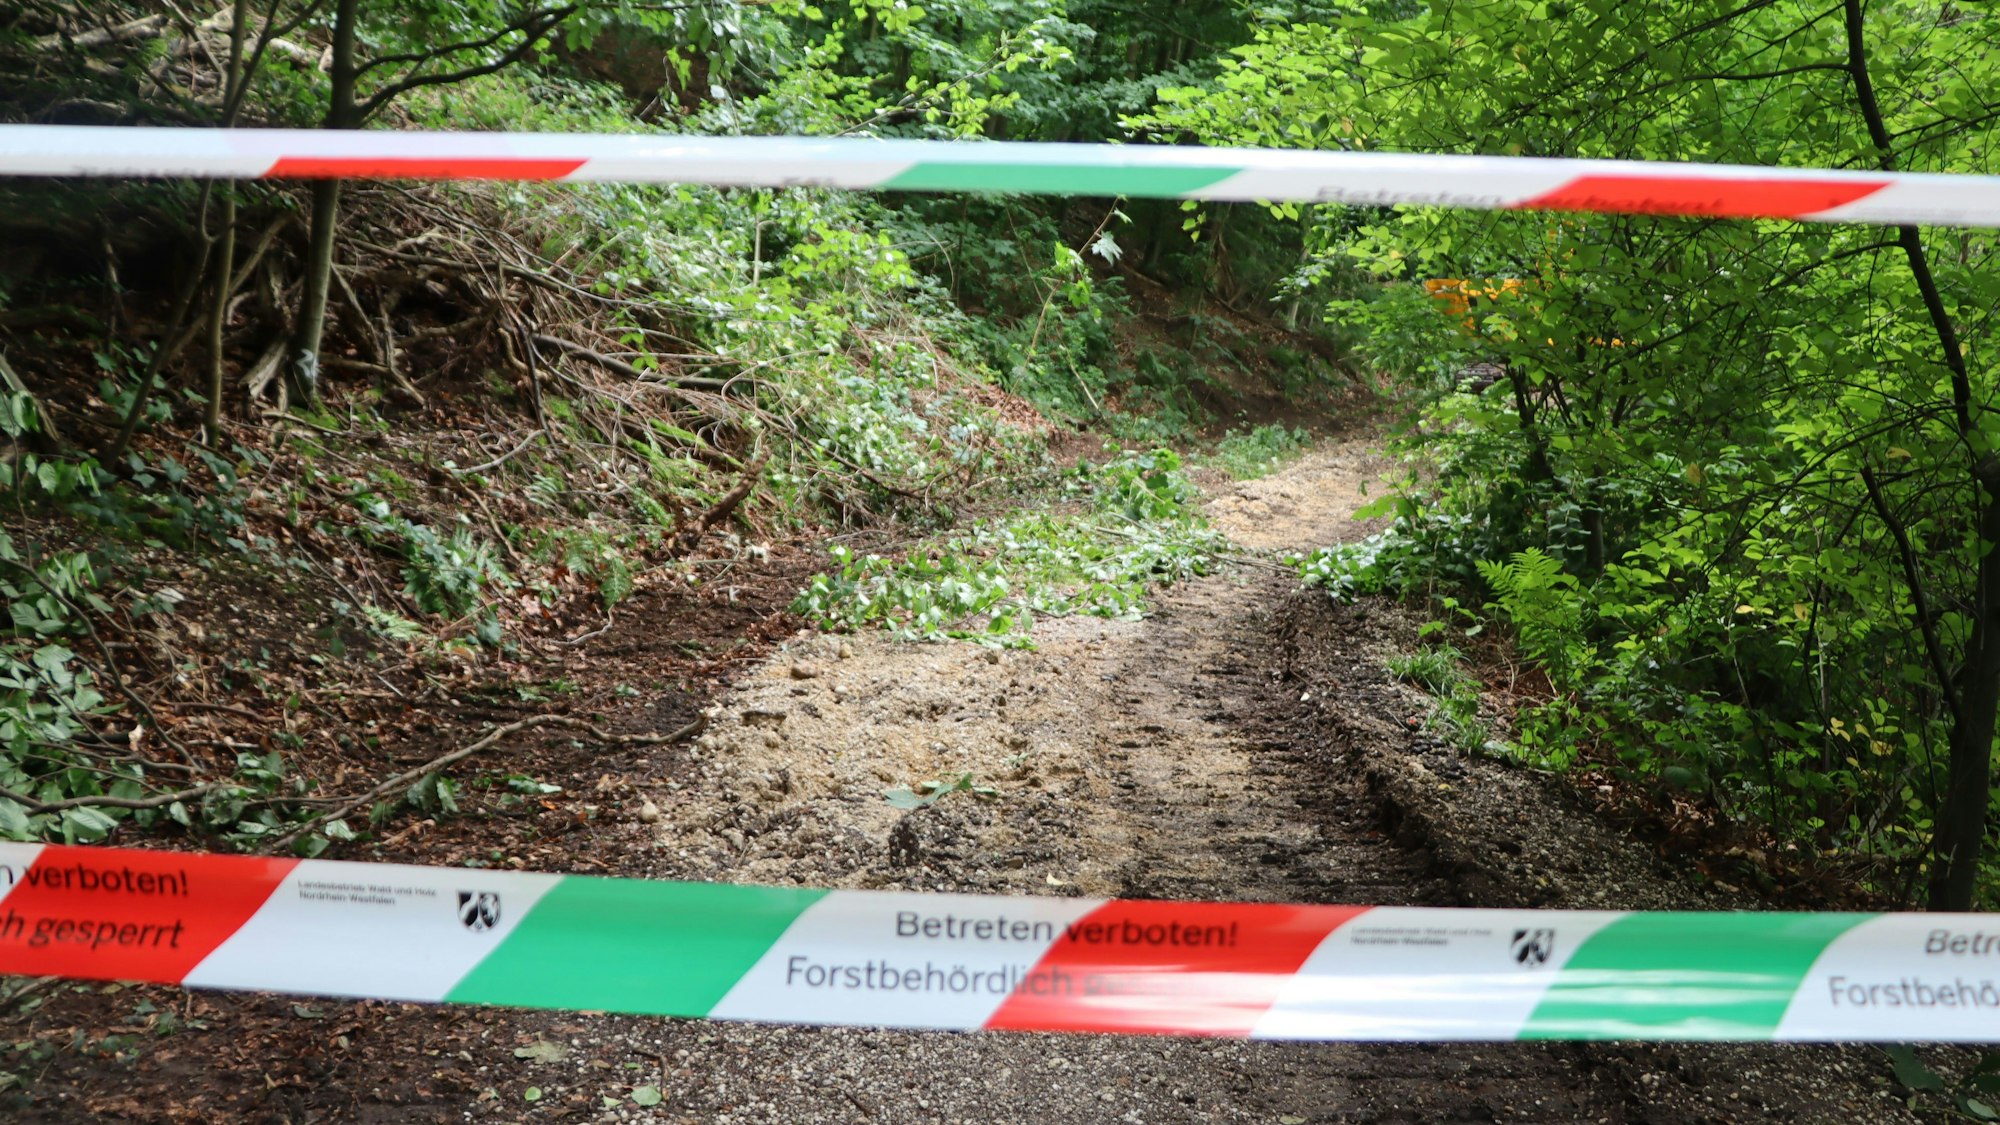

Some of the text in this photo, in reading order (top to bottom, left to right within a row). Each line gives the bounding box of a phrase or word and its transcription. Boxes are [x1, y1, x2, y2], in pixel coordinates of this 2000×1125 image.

[25, 863, 188, 896] verboten!
[29, 915, 184, 951] gesperrt
[895, 911, 1239, 948] Betreten verboten!
[1925, 929, 2000, 955] Betr
[786, 955, 1072, 995] Forstbehördlich
